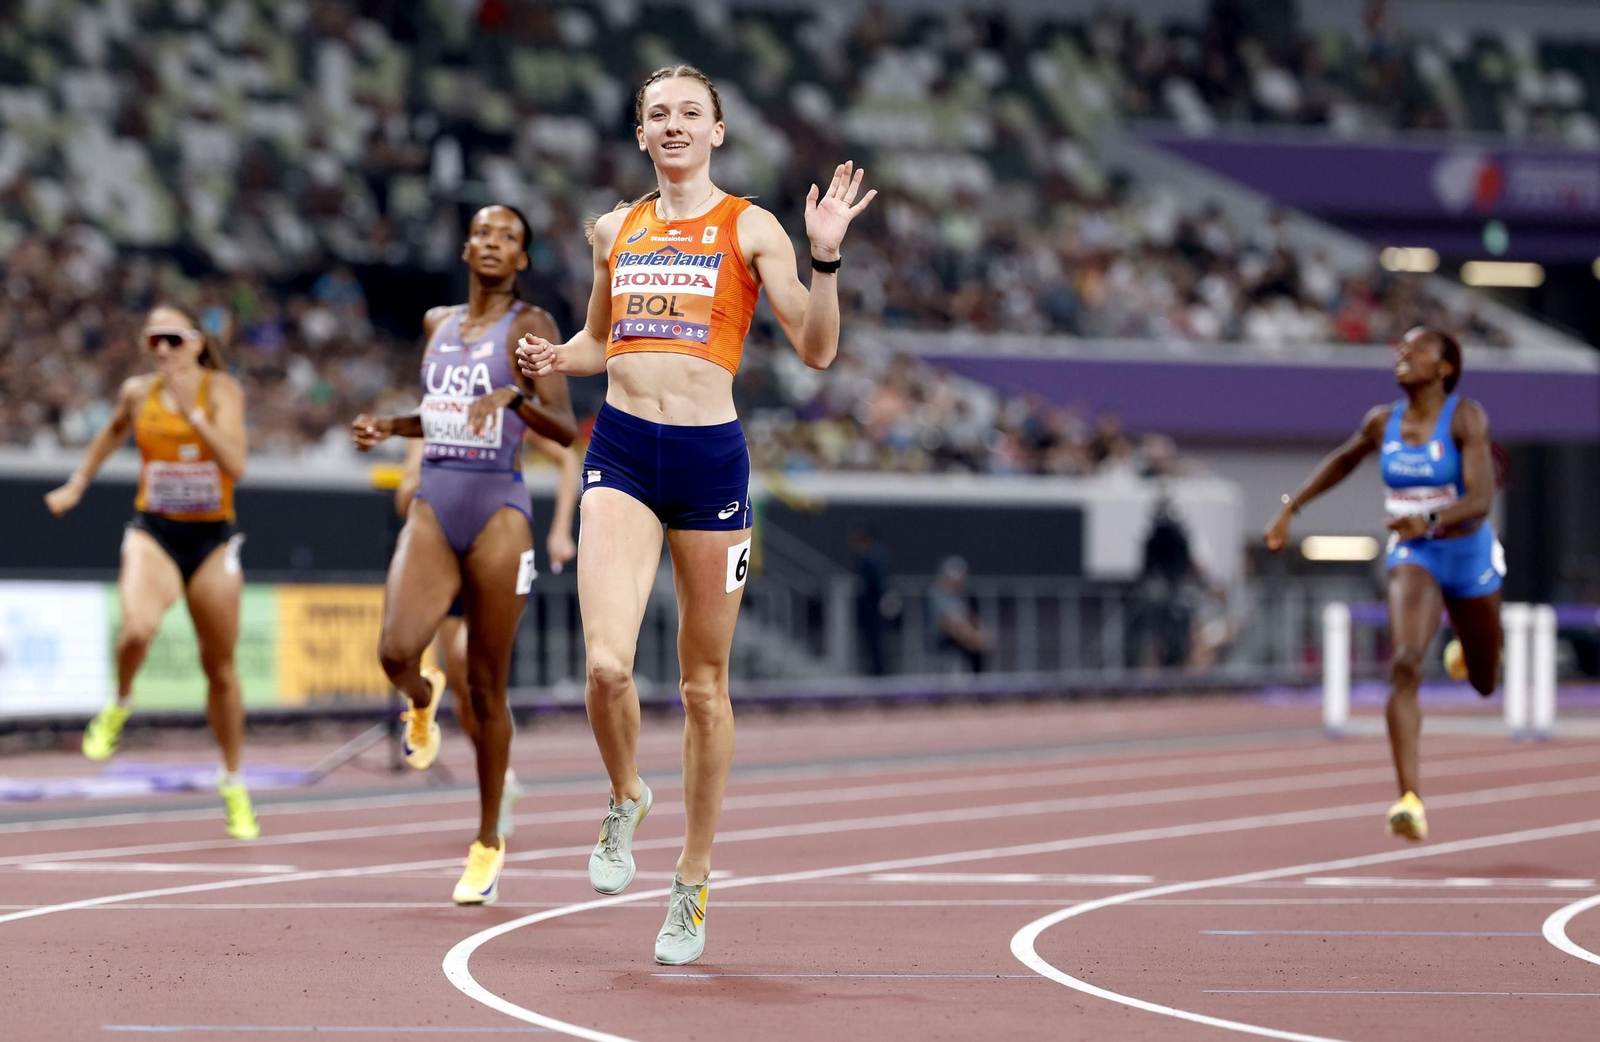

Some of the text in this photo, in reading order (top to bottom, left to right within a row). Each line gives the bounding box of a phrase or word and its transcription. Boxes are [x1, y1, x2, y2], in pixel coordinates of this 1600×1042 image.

[613, 273, 713, 289] HONDA
[626, 294, 685, 318] BOL
[426, 361, 494, 397] USA
[735, 548, 748, 582] 6
